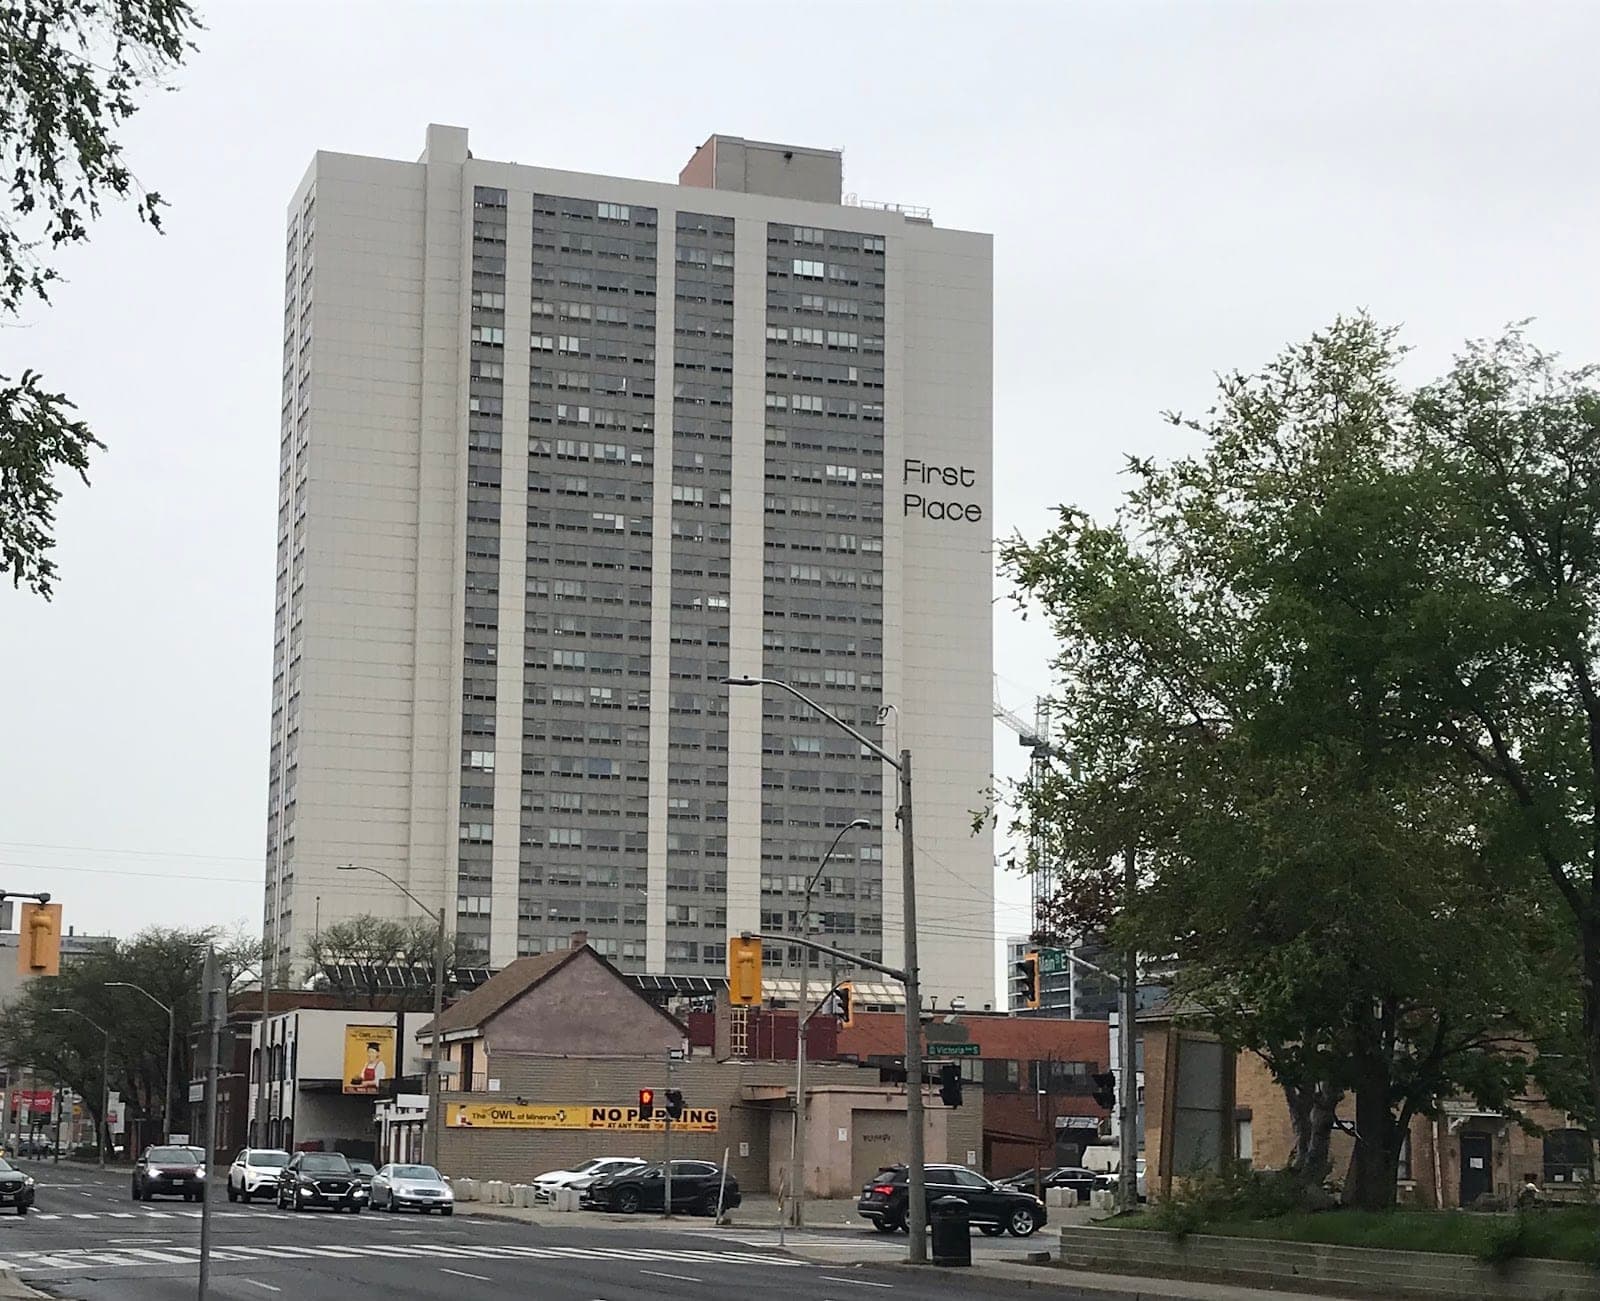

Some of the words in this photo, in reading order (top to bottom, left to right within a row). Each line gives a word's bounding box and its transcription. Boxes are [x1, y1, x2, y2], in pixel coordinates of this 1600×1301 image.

[904, 459, 976, 488] First
[904, 493, 983, 523] Place
[936, 1046, 965, 1056] Victoria
[472, 1112, 486, 1120] The
[491, 1110, 516, 1120] OWL
[526, 1113, 557, 1121] Minerva
[592, 1108, 622, 1121] NO
[627, 1109, 717, 1123] PRING
